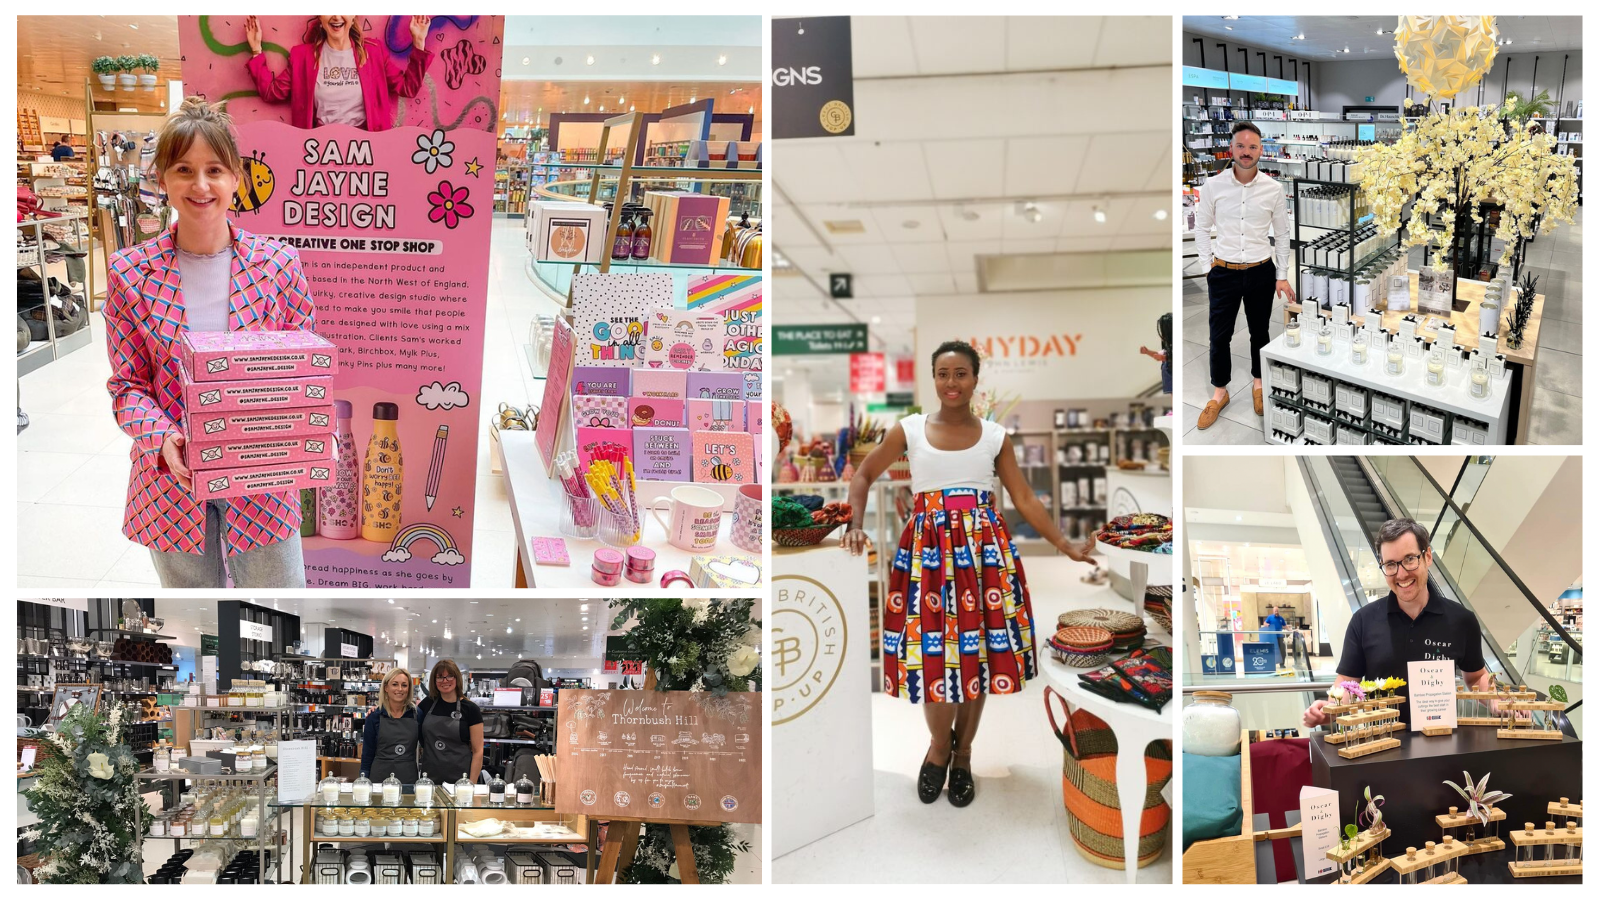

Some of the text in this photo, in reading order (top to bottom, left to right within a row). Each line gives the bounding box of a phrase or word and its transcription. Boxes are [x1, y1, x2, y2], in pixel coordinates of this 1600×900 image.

[323, 66, 358, 80] LOVE
[772, 66, 822, 86] GNS
[304, 138, 373, 166] SAM
[290, 170, 388, 197] JAYNE
[283, 200, 395, 229] DESIGN
[340, 239, 366, 250] ONE
[370, 240, 400, 252] STOP
[402, 240, 435, 253] SHOP
[334, 262, 388, 271] independent
[390, 264, 425, 272] product
[368, 277, 393, 285] North
[396, 278, 417, 286] West
[378, 292, 406, 302] design
[415, 308, 432, 316] that
[436, 309, 465, 318] people
[338, 319, 376, 328] designed
[422, 323, 443, 332] using
[455, 323, 469, 331] mix
[369, 334, 398, 342] Clients
[428, 337, 462, 345] worked
[777, 330, 852, 340] THE PLACE TO EAT
[358, 347, 396, 356] Birchbox,
[400, 349, 417, 358] Mylk
[421, 350, 440, 359] Plus,
[226, 386, 299, 394] WWW.SAMJAYNEDESIGN.CO.UK
[231, 414, 303, 423] WWW.SAMJAYNEDESIGN.CO.UK
[228, 441, 298, 451] WWW.SAMJAYNEDESIGN.CO.UK
[705, 443, 736, 455] LET'S
[234, 469, 304, 480] WWW.SAMJAYNEDESIGN.CO.UK
[332, 565, 378, 575] happiness
[416, 572, 438, 581] goes
[442, 573, 453, 583] by
[318, 579, 348, 587] Dream
[778, 589, 836, 655] BRITISH
[1424, 638, 1452, 647] Oscar
[623, 697, 673, 717] Welcome to
[612, 713, 698, 726] Thornbush Hill
